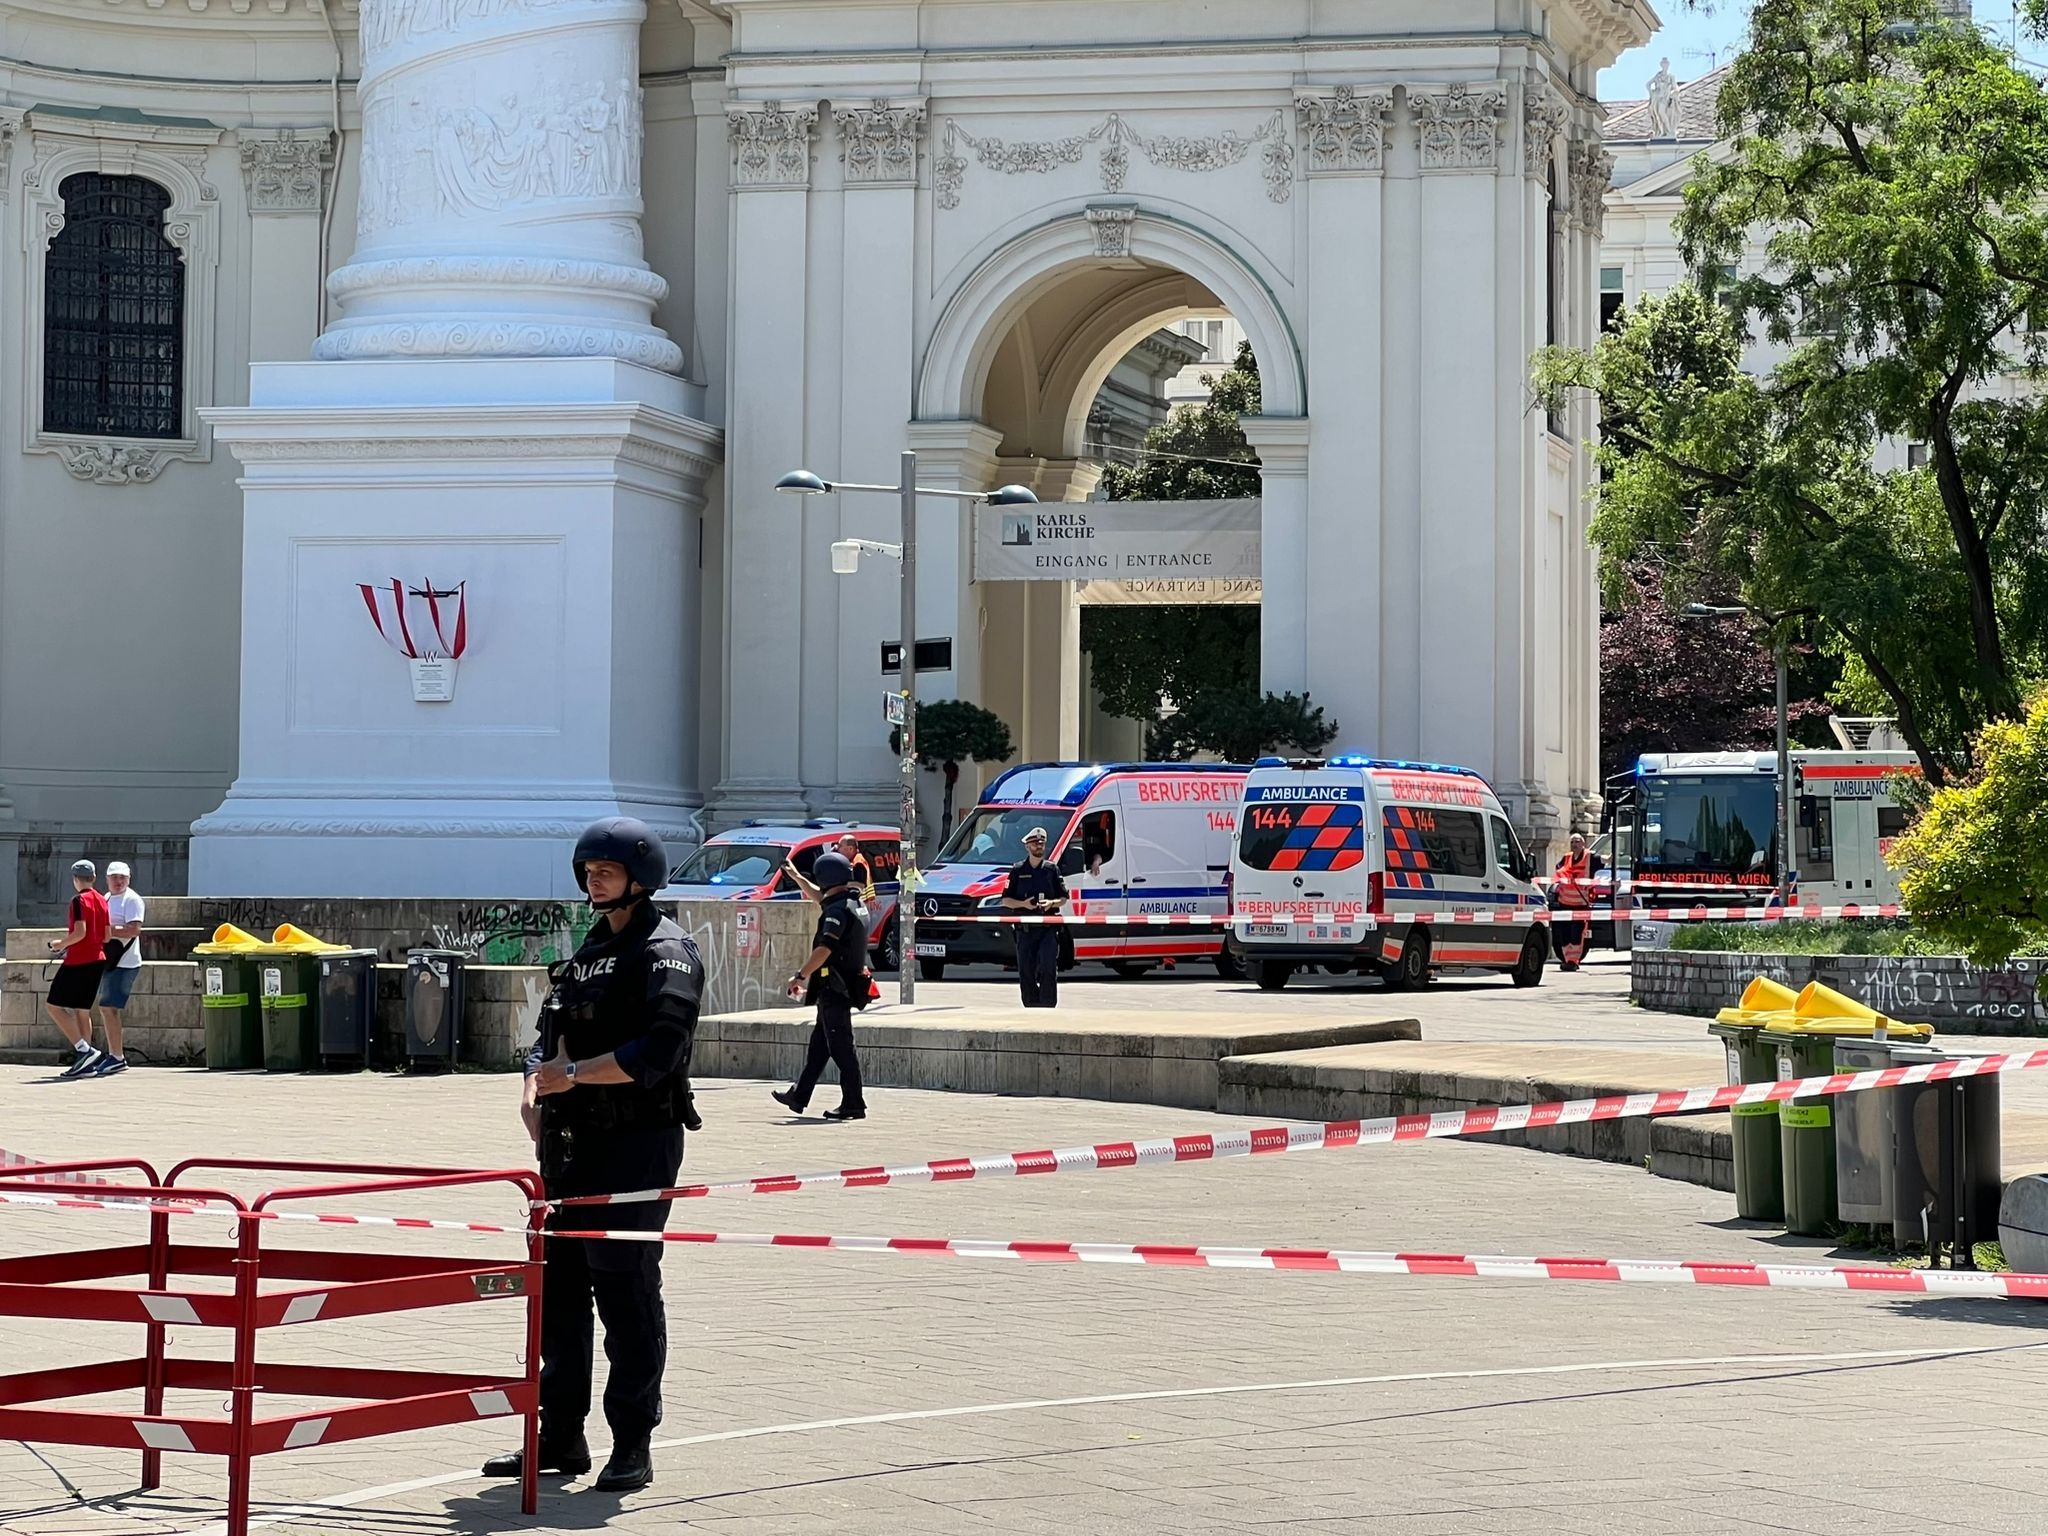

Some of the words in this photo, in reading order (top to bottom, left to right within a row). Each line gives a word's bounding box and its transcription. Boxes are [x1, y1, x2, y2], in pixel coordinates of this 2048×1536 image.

[1036, 514, 1087, 526] KARLS
[1037, 526, 1095, 539] KIRCHE
[1035, 555, 1108, 568] EINGANG
[1126, 552, 1213, 568] ENTRANCE
[1261, 787, 1349, 801] AMBULANCE
[1391, 779, 1484, 807] BERUFSRETTUNG
[1206, 811, 1236, 832] 144
[1251, 807, 1292, 830] 144
[1414, 809, 1436, 833] 144
[1736, 874, 1771, 886] WIEN
[1139, 901, 1198, 914] AMBULANCE
[652, 958, 693, 975] POLIZEI
